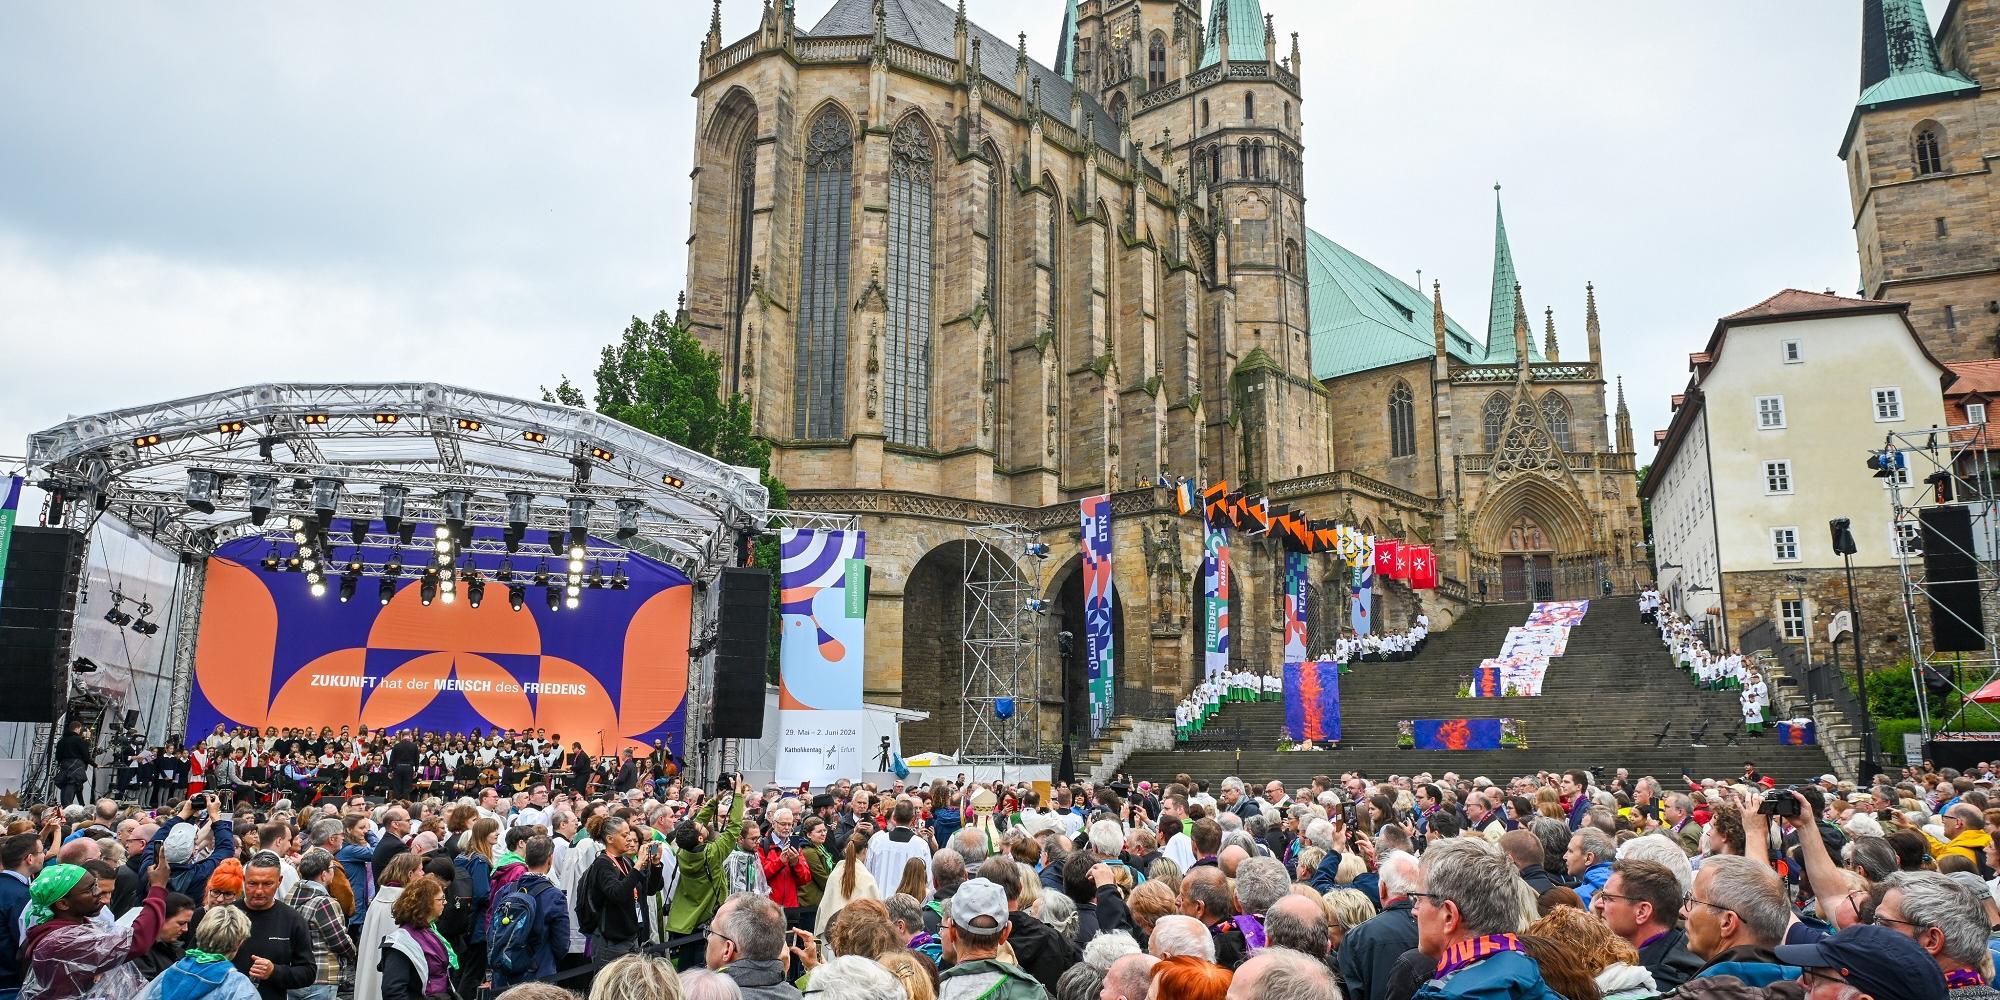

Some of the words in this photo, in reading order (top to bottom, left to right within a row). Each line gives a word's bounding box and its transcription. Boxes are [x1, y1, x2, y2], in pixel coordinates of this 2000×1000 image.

[1098, 515, 1108, 542] אדם
[851, 563, 859, 614] katholikentag.de
[1207, 601, 1216, 648] FRIEDEN
[310, 674, 377, 688] ZUKUNFT
[380, 677, 402, 689] hat
[406, 678, 430, 690] der
[433, 679, 491, 692] MENSCH
[495, 681, 519, 693] des
[523, 682, 586, 696] FRIEDENS
[784, 746, 822, 754] Katholikentag
